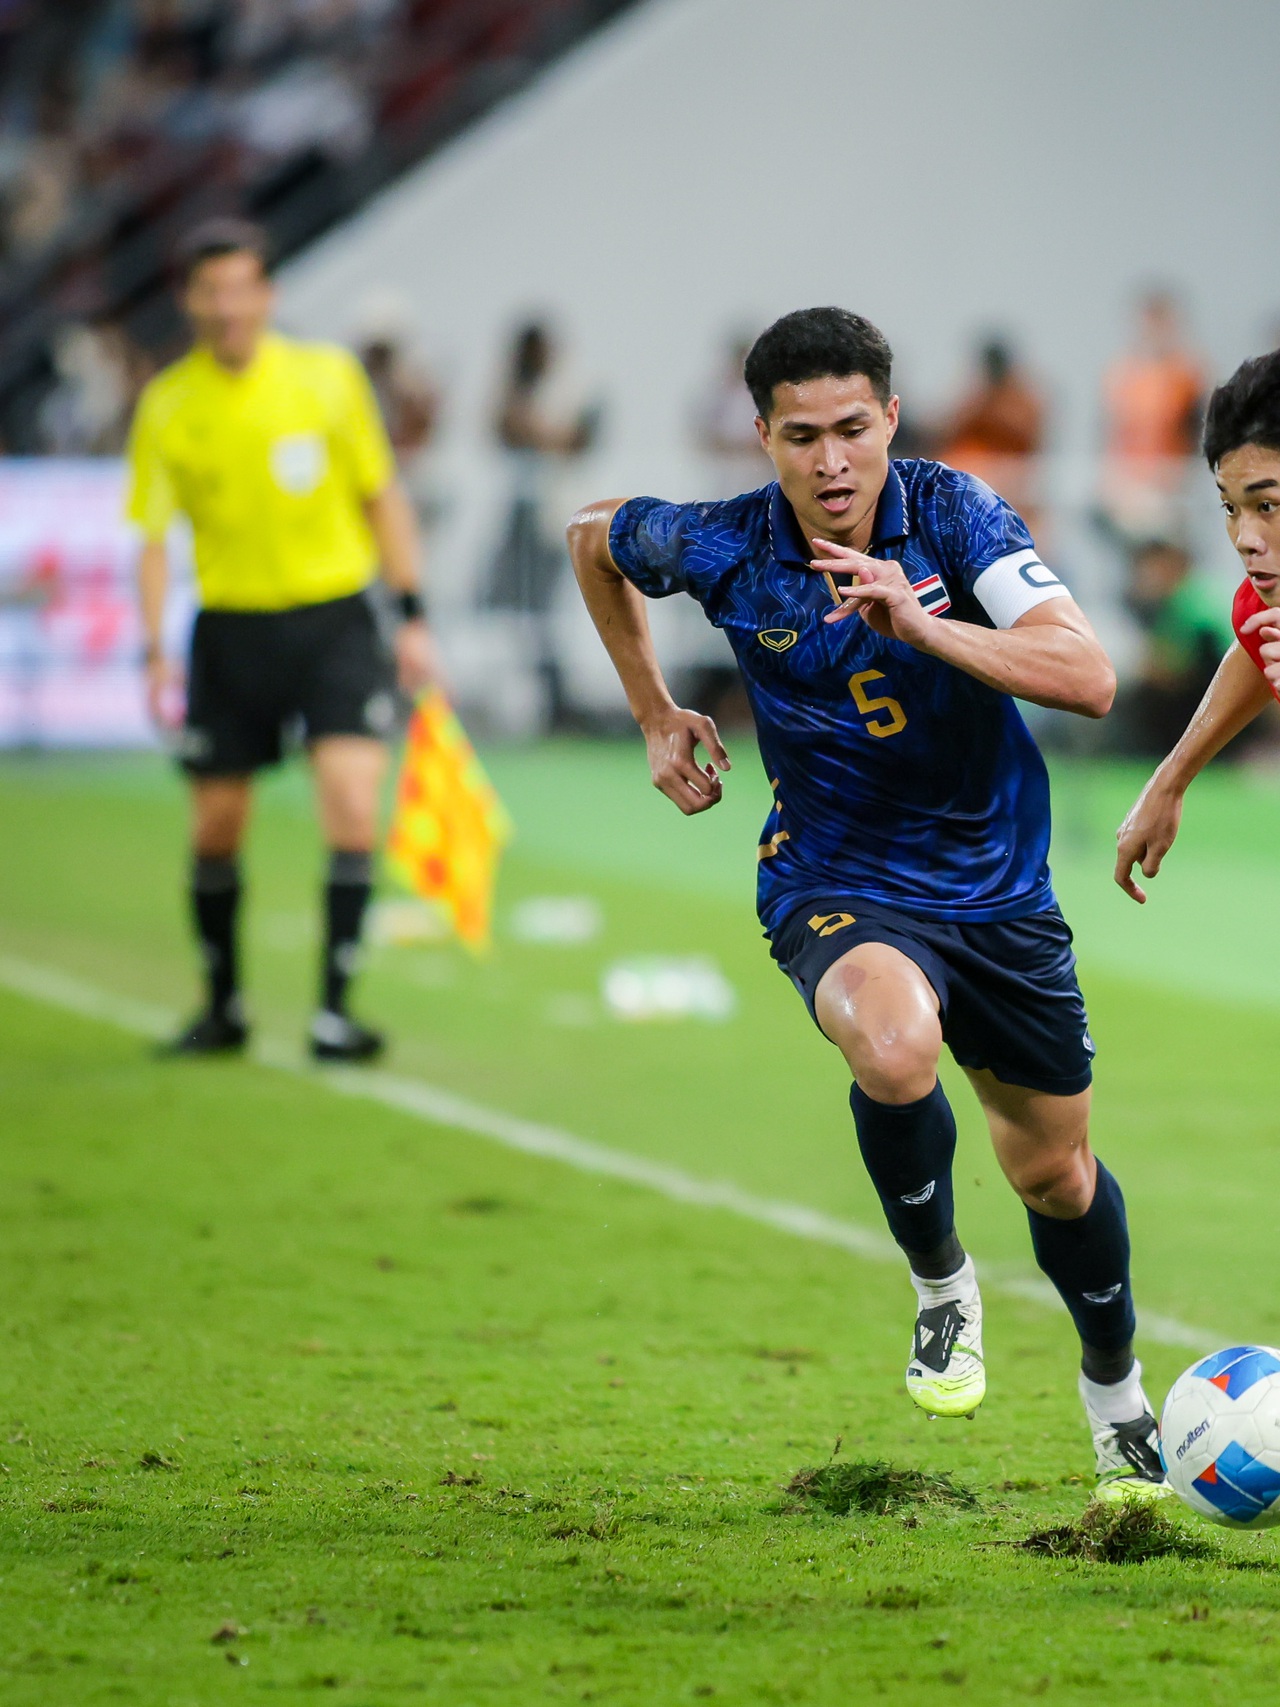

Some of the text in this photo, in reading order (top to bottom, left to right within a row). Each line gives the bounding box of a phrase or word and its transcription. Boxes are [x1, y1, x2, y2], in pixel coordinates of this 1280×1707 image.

[1018, 561, 1062, 588] C
[848, 669, 907, 738] 5
[1176, 1418, 1210, 1460] molten
